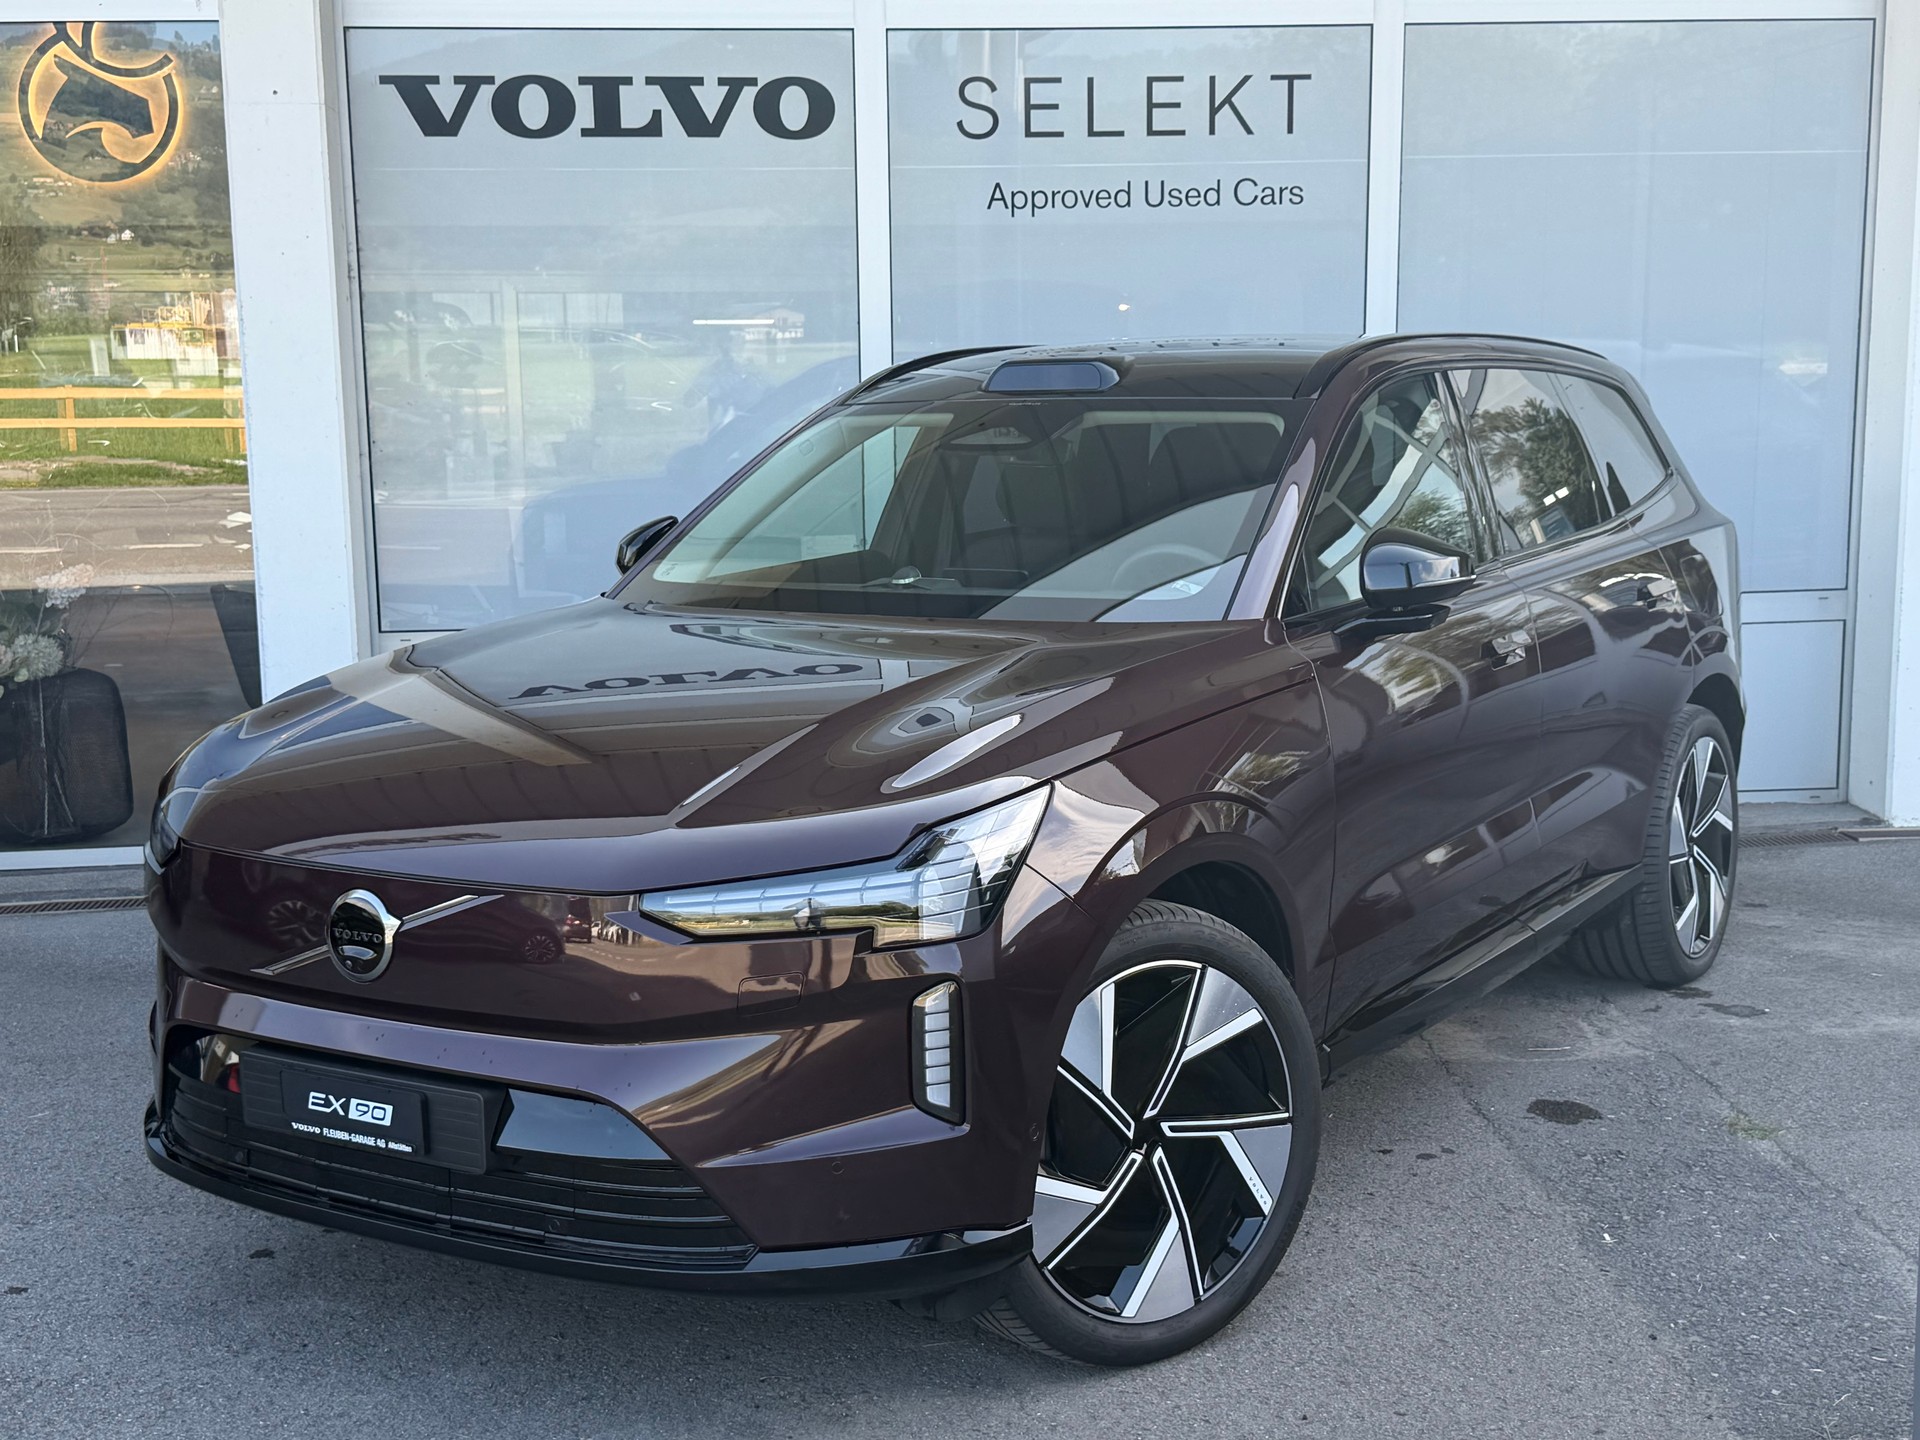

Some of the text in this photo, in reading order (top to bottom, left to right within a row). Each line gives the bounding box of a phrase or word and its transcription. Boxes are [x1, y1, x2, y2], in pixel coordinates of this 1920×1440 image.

[378, 74, 836, 140] VOLVO
[956, 73, 1313, 140] SELEKT
[987, 177, 1304, 218] Approved Used Cars
[332, 928, 382, 943] VOLVO
[291, 1122, 321, 1134] VOLVO
[376, 1138, 386, 1148] AG
